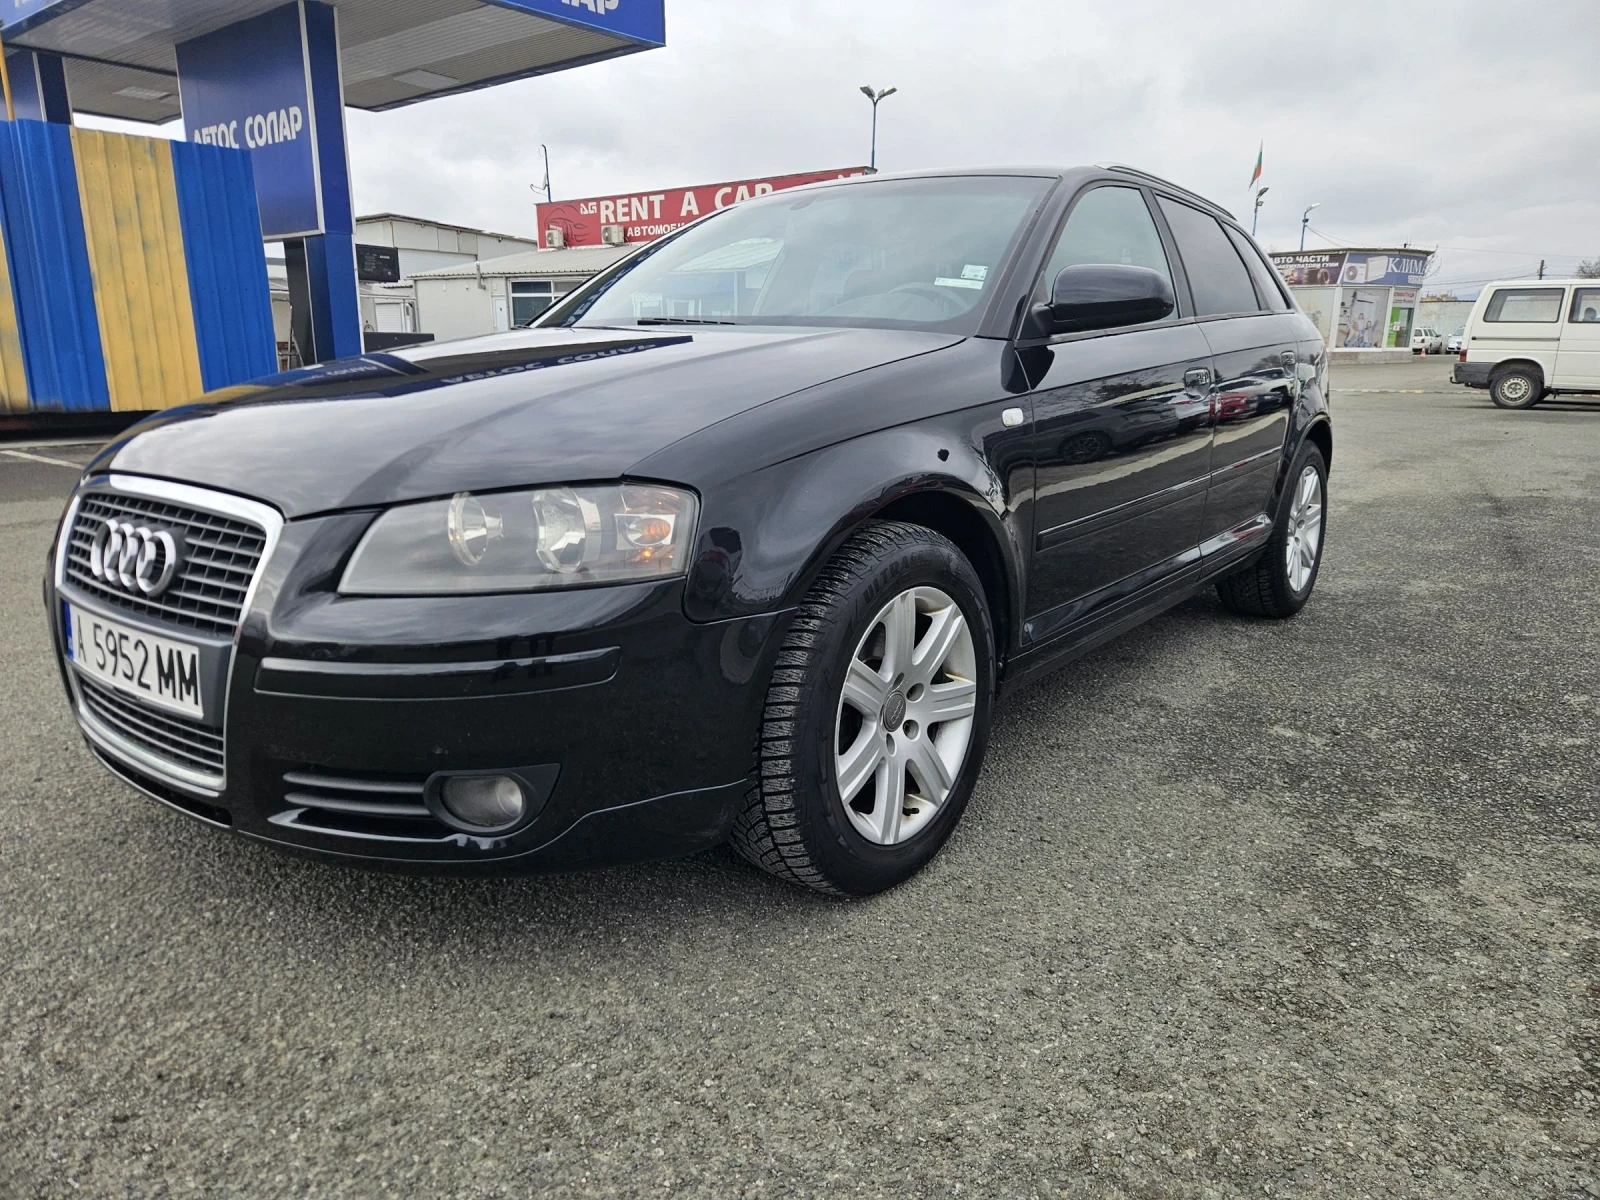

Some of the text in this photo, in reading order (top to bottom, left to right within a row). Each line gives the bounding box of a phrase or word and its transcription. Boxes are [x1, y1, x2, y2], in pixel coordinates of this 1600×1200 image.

[600, 194, 665, 223] RENT
[680, 191, 699, 217] A
[1295, 255, 1330, 263] ЧАСТИ
[77, 614, 199, 706] A 5952 MM
